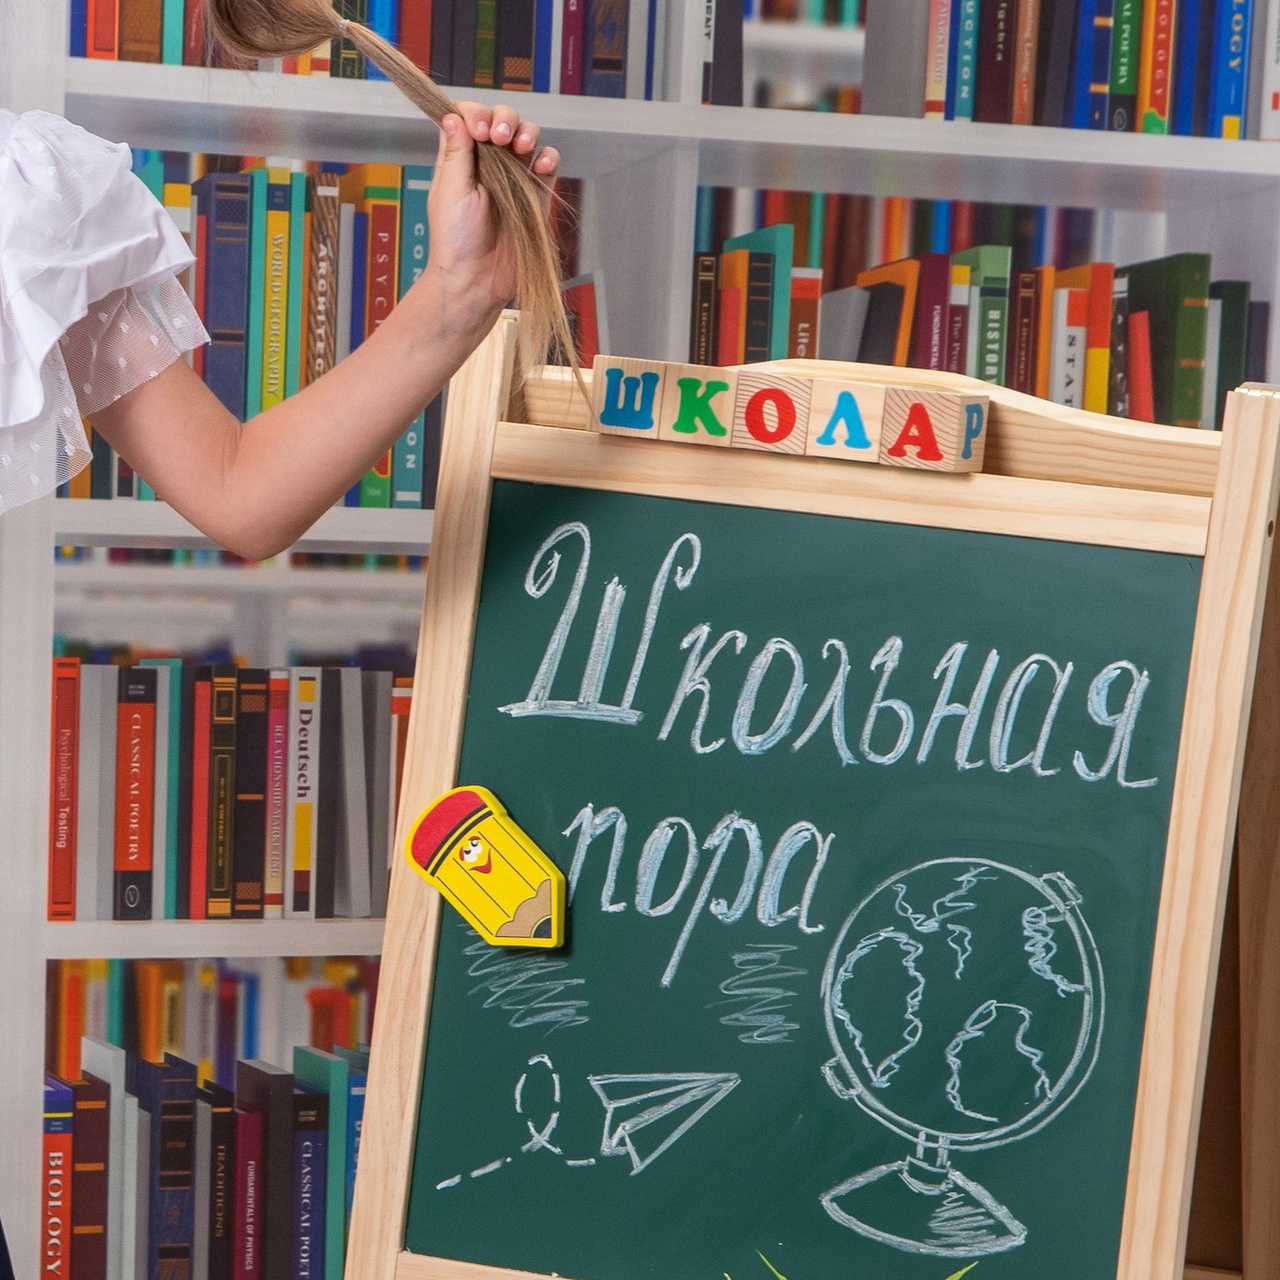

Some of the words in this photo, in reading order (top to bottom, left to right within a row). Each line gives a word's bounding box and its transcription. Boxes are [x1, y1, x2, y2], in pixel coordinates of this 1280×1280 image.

[1117, 23, 1133, 87] POETRY
[269, 233, 285, 294] WORLD
[266, 296, 284, 398] GEOGRAPHY
[314, 242, 329, 377] ARCHITEC
[600, 366, 946, 463] ШКОЛА
[497, 520, 1158, 788] Школьная
[57, 727, 73, 802] Psychological
[129, 713, 142, 799] CLASSICAL
[271, 723, 284, 805] RELATIONSHIP
[296, 708, 314, 799] Deutsch
[54, 805, 71, 850] Testing
[128, 802, 141, 864] POETRY
[269, 805, 282, 879] MARKETING
[561, 800, 836, 987] пора
[46, 1149, 64, 1277] BIOLOGY
[214, 1142, 227, 1239] TRADITIONS
[245, 1160, 256, 1224] FUNDAMENTALS
[299, 1140, 314, 1231] CLASSICAL
[244, 1236, 255, 1271] PHYSICS
[245, 1224, 256, 1236] OF
